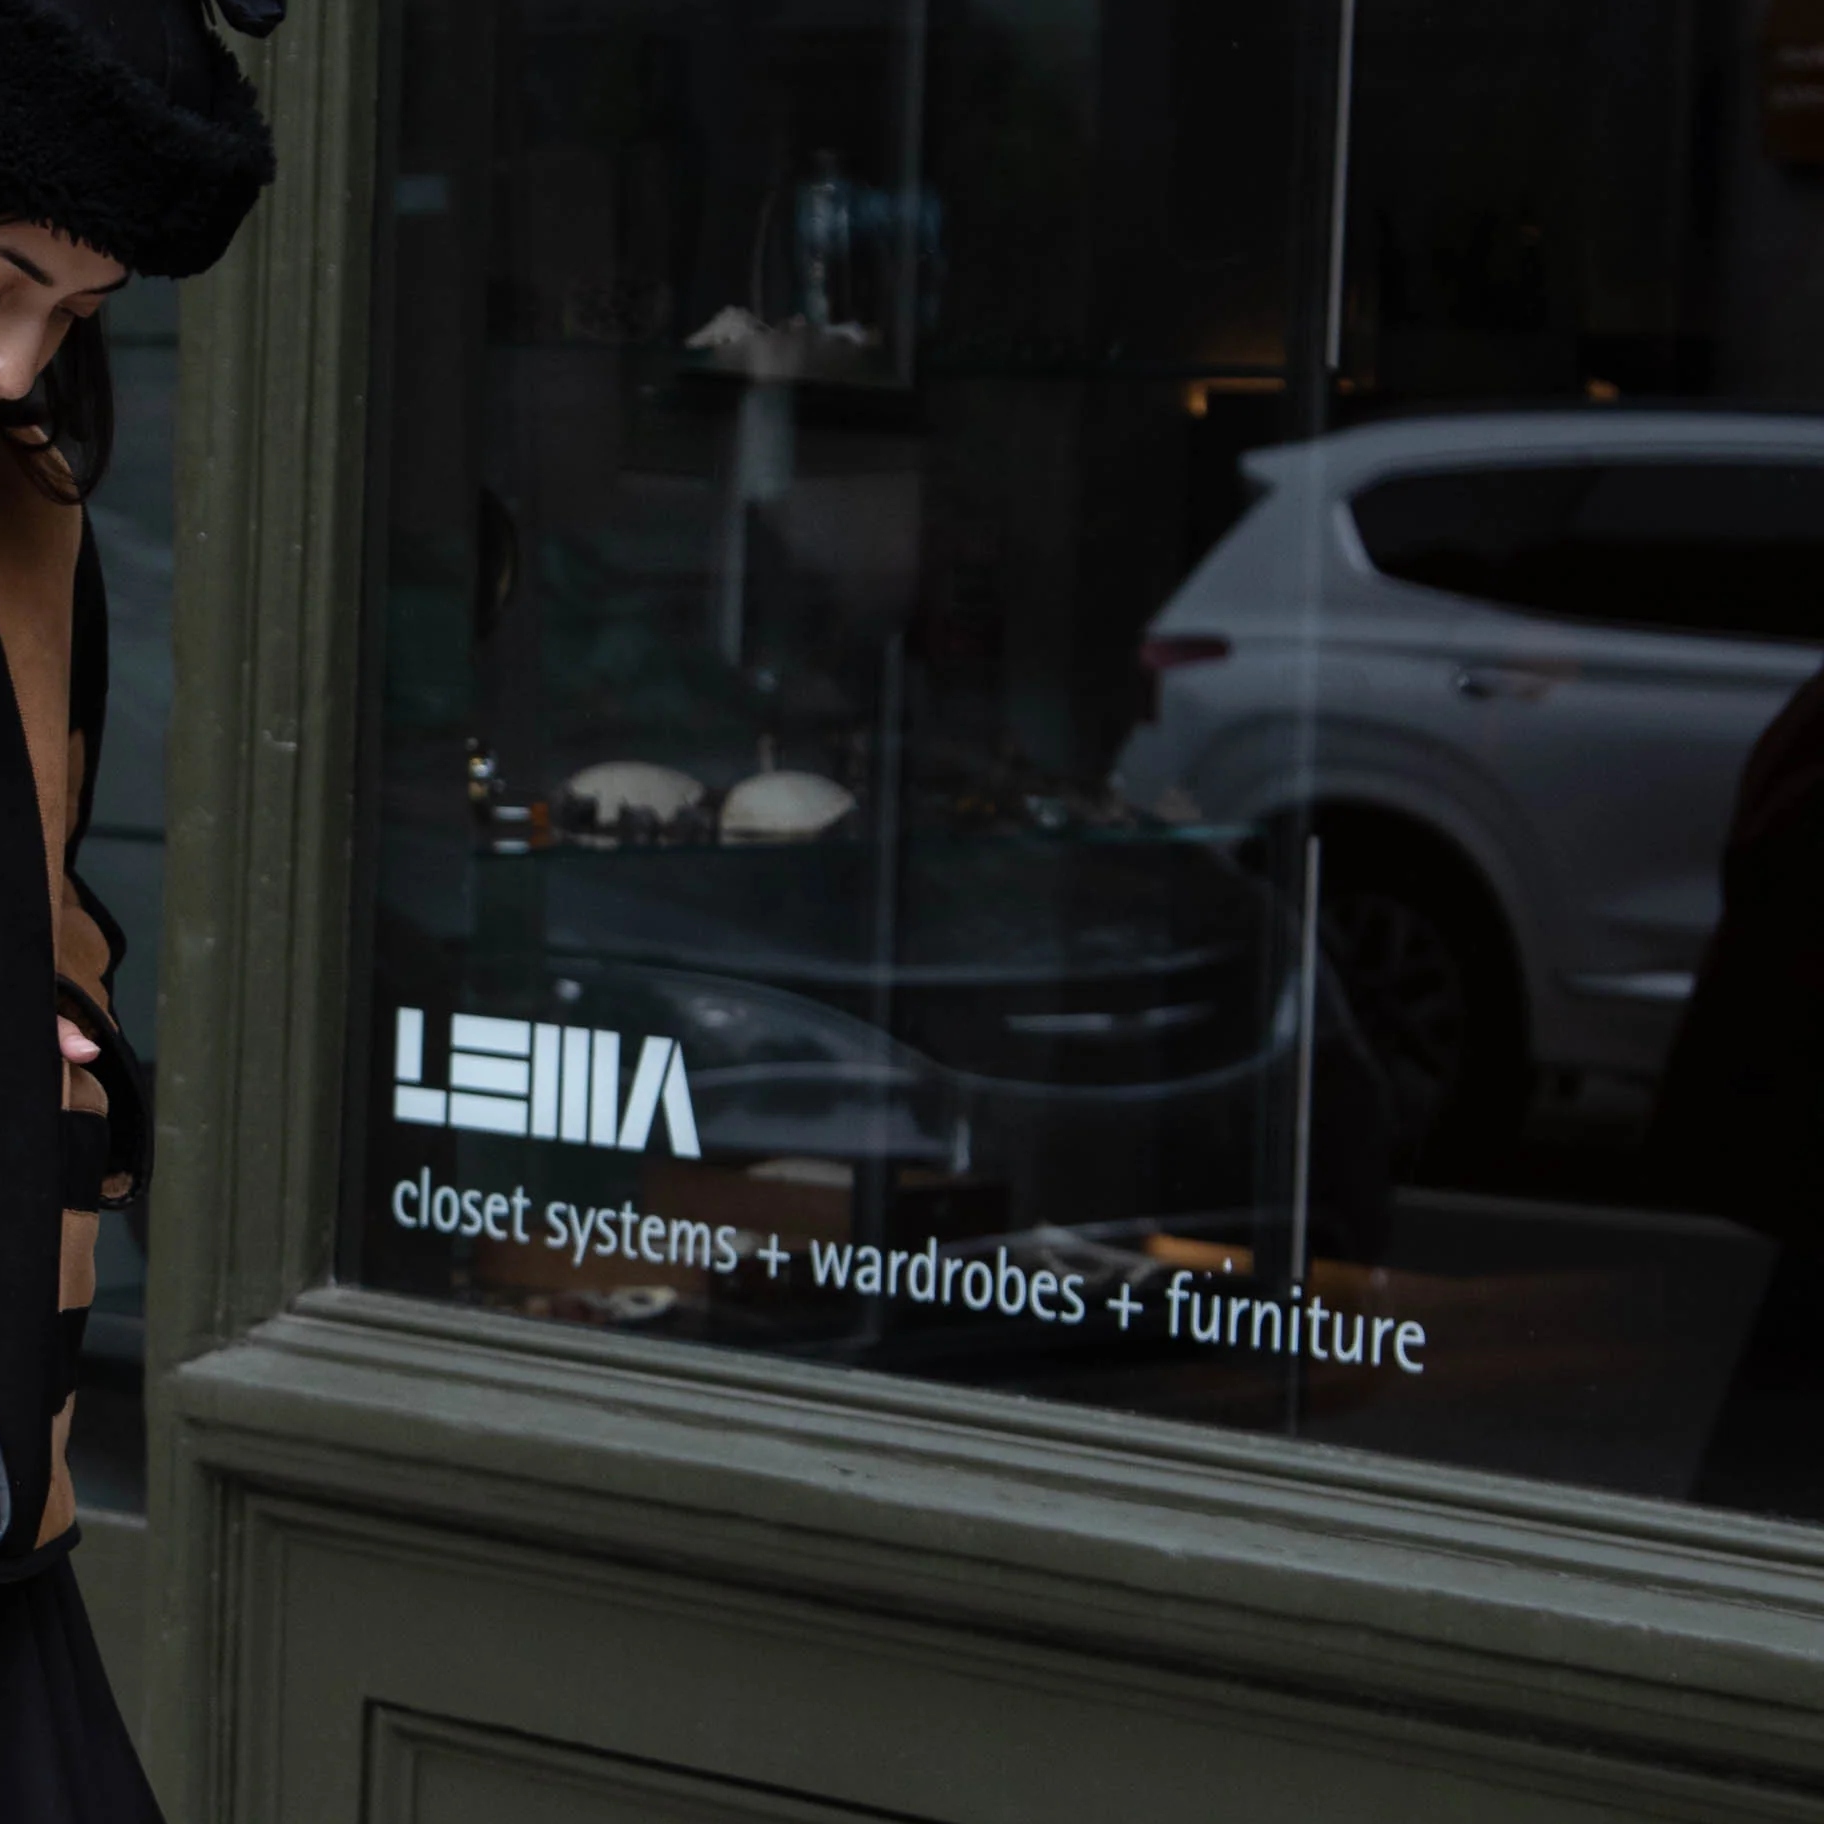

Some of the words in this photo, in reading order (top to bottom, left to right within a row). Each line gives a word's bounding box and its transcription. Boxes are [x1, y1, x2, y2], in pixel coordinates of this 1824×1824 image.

[392, 1165, 532, 1244] closet
[545, 1200, 746, 1273] systems
[810, 1236, 1086, 1323] wardrobes
[1166, 1269, 1427, 1373] furniture
